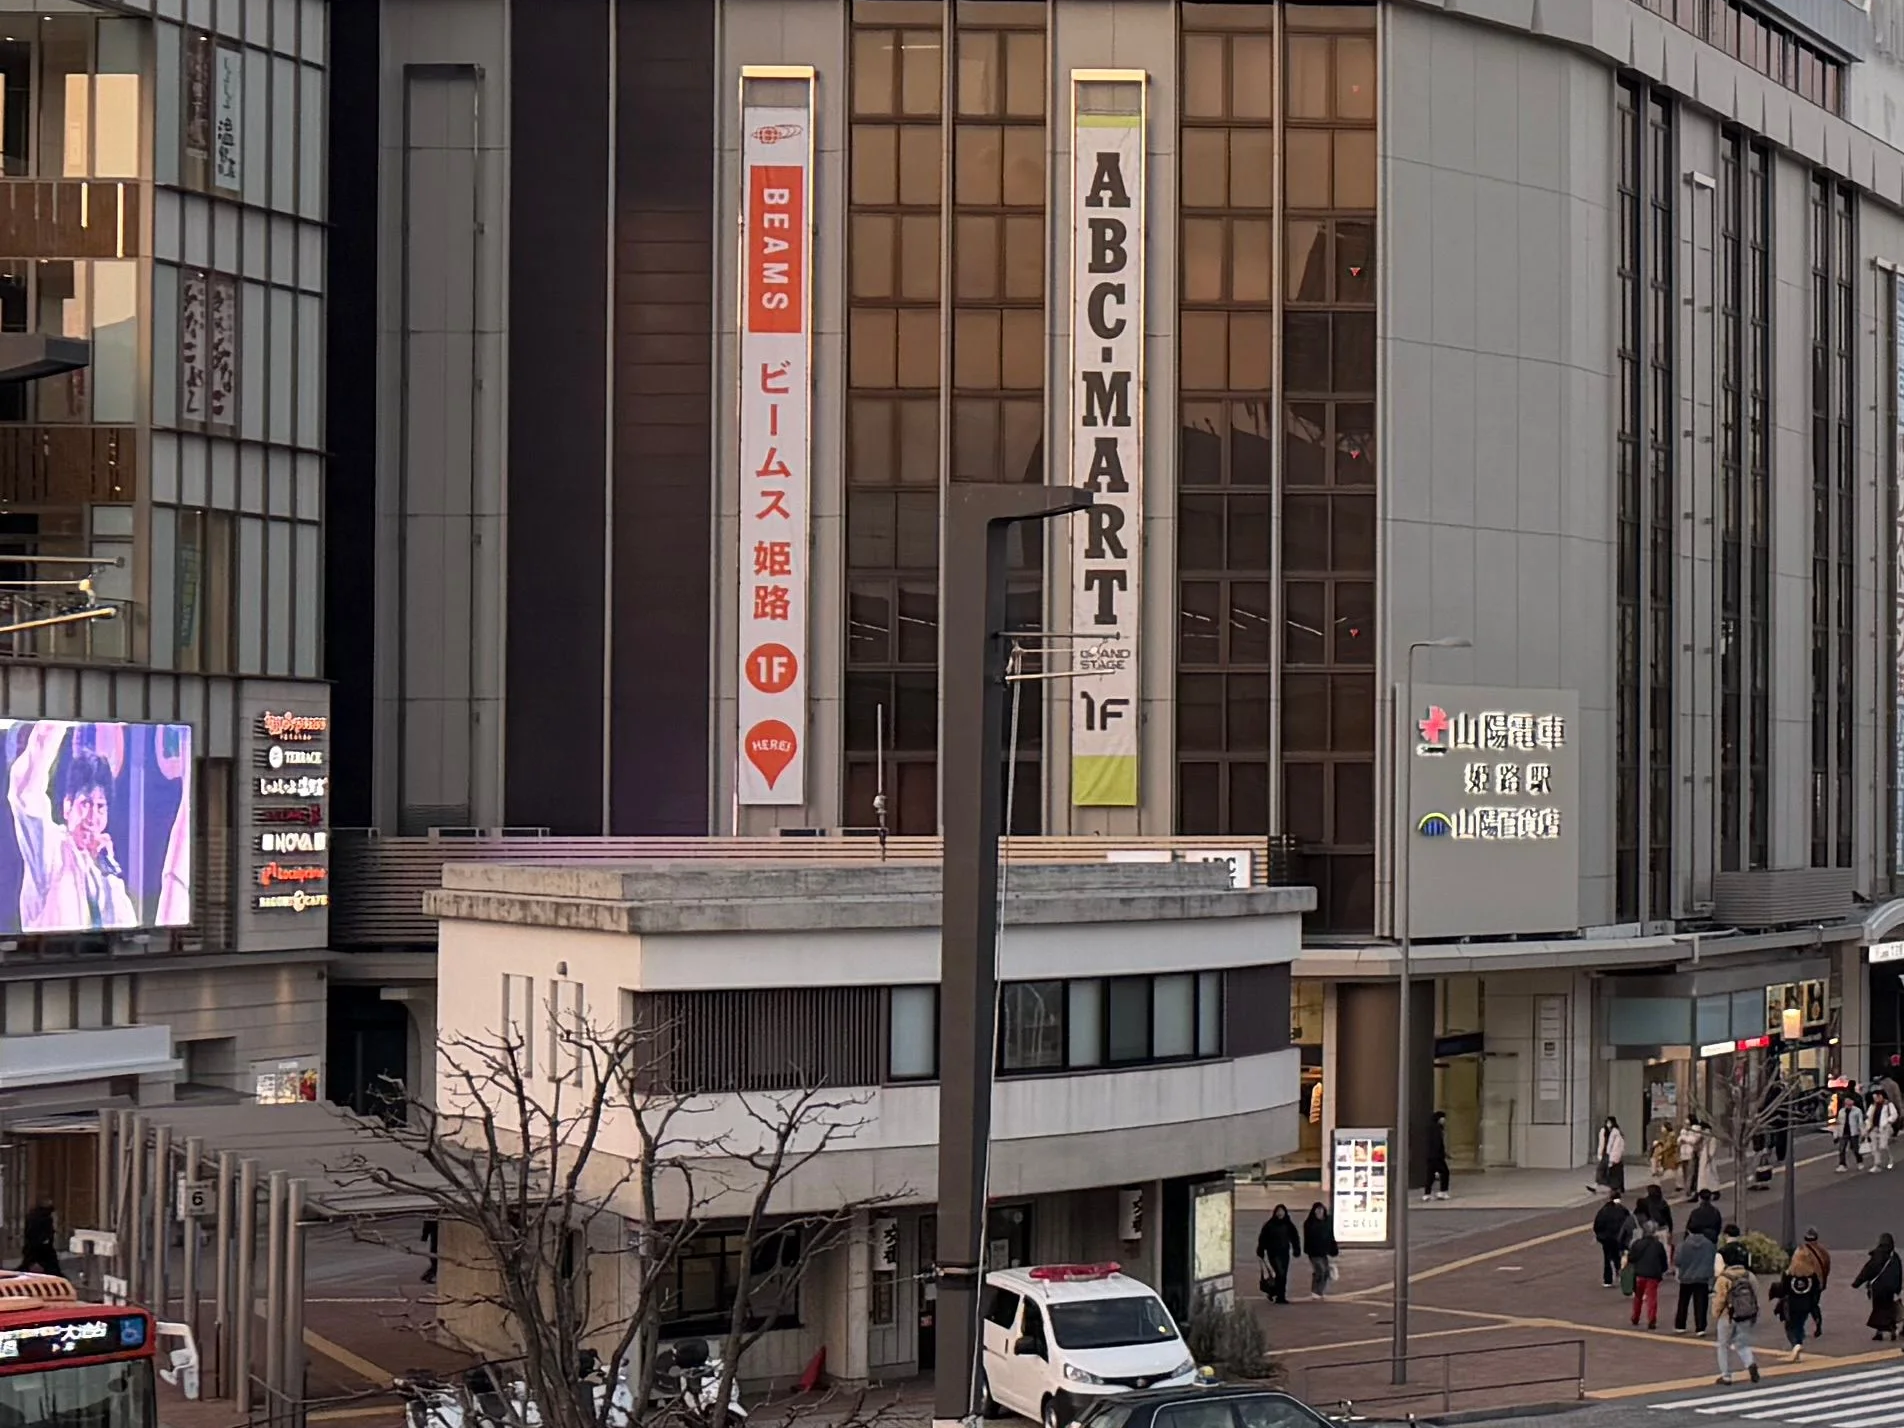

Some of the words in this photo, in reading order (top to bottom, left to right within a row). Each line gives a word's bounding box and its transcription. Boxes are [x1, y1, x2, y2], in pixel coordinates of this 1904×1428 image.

[762, 187, 792, 311] BEAMS
[755, 361, 792, 520] ビームス
[752, 540, 792, 623] 姫路
[756, 654, 787, 684] 1F
[1080, 690, 1130, 732] 1F
[1448, 710, 1567, 752] 山陽電車
[1463, 761, 1552, 797] 姫路駅
[1451, 807, 1561, 841] 山陽百貨店
